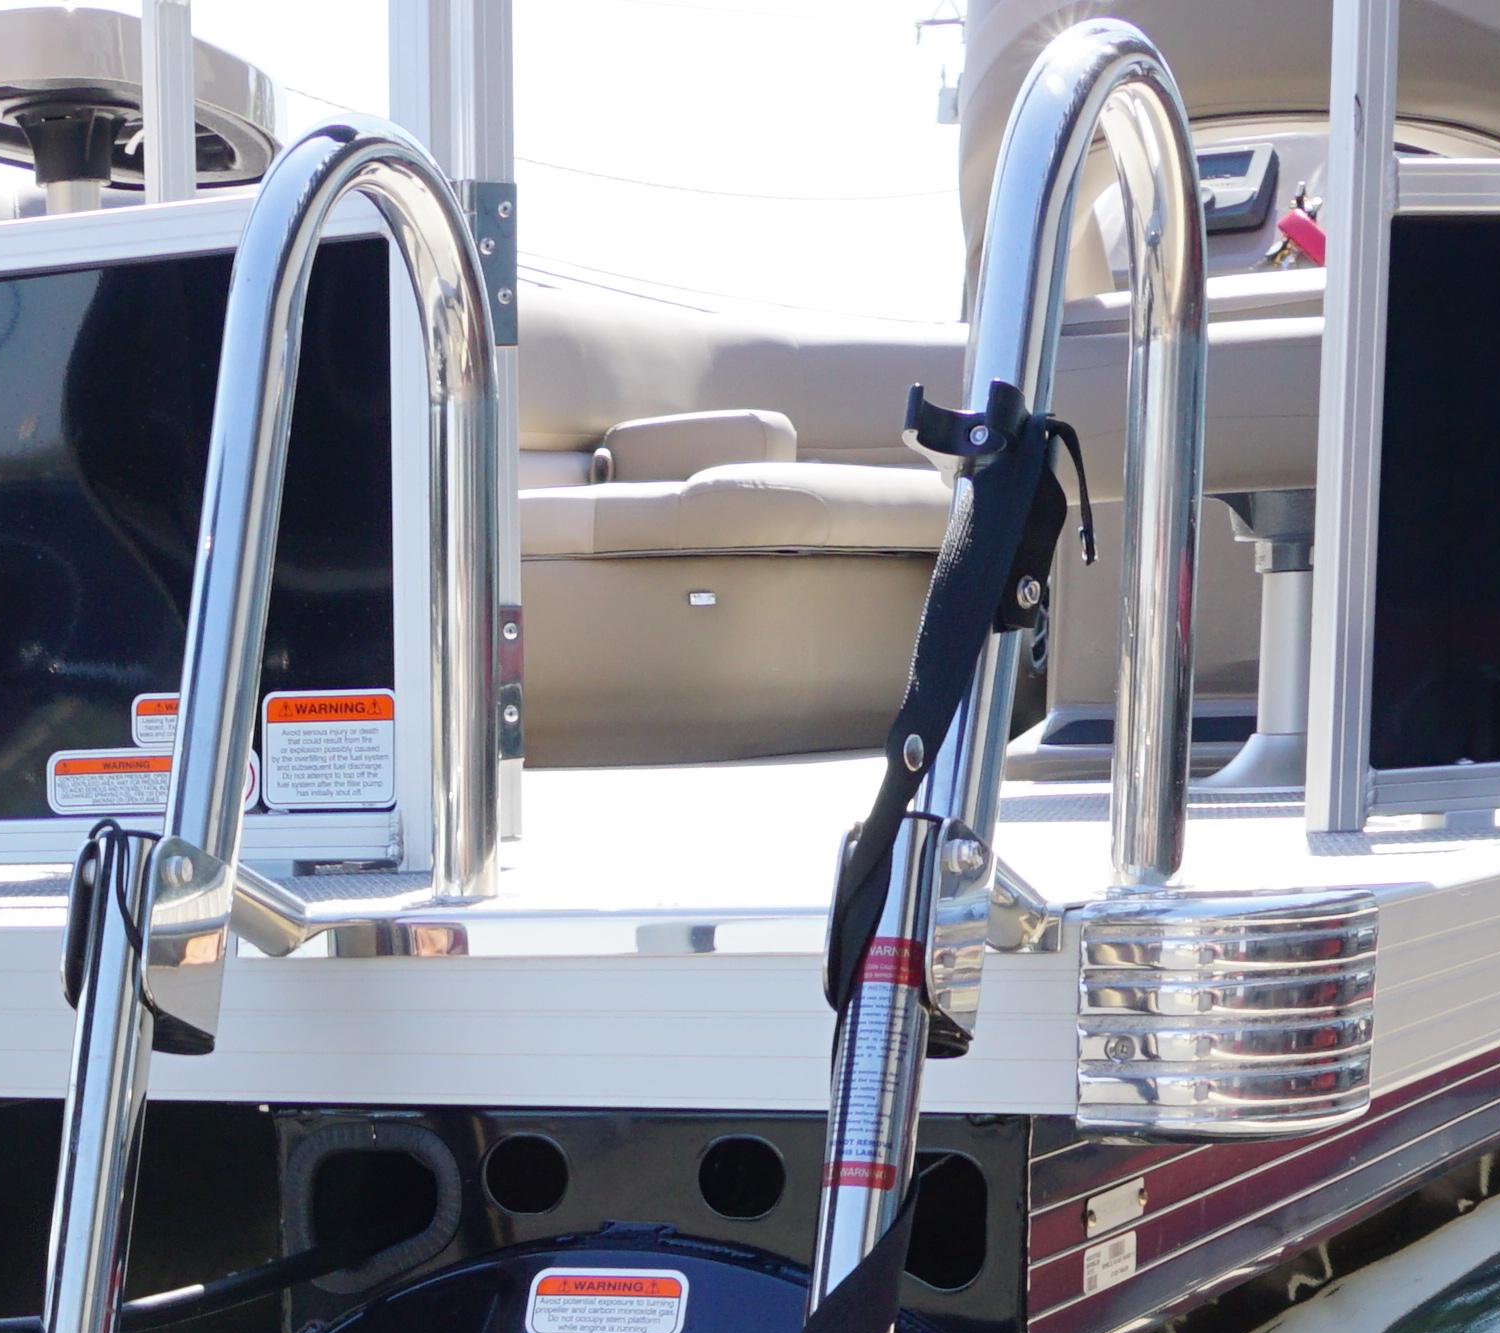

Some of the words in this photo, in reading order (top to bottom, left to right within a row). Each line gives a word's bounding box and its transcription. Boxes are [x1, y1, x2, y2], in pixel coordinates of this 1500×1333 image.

[295, 702, 365, 714] WARNING
[102, 761, 150, 770] WARNING
[574, 1281, 644, 1292] WARNING
